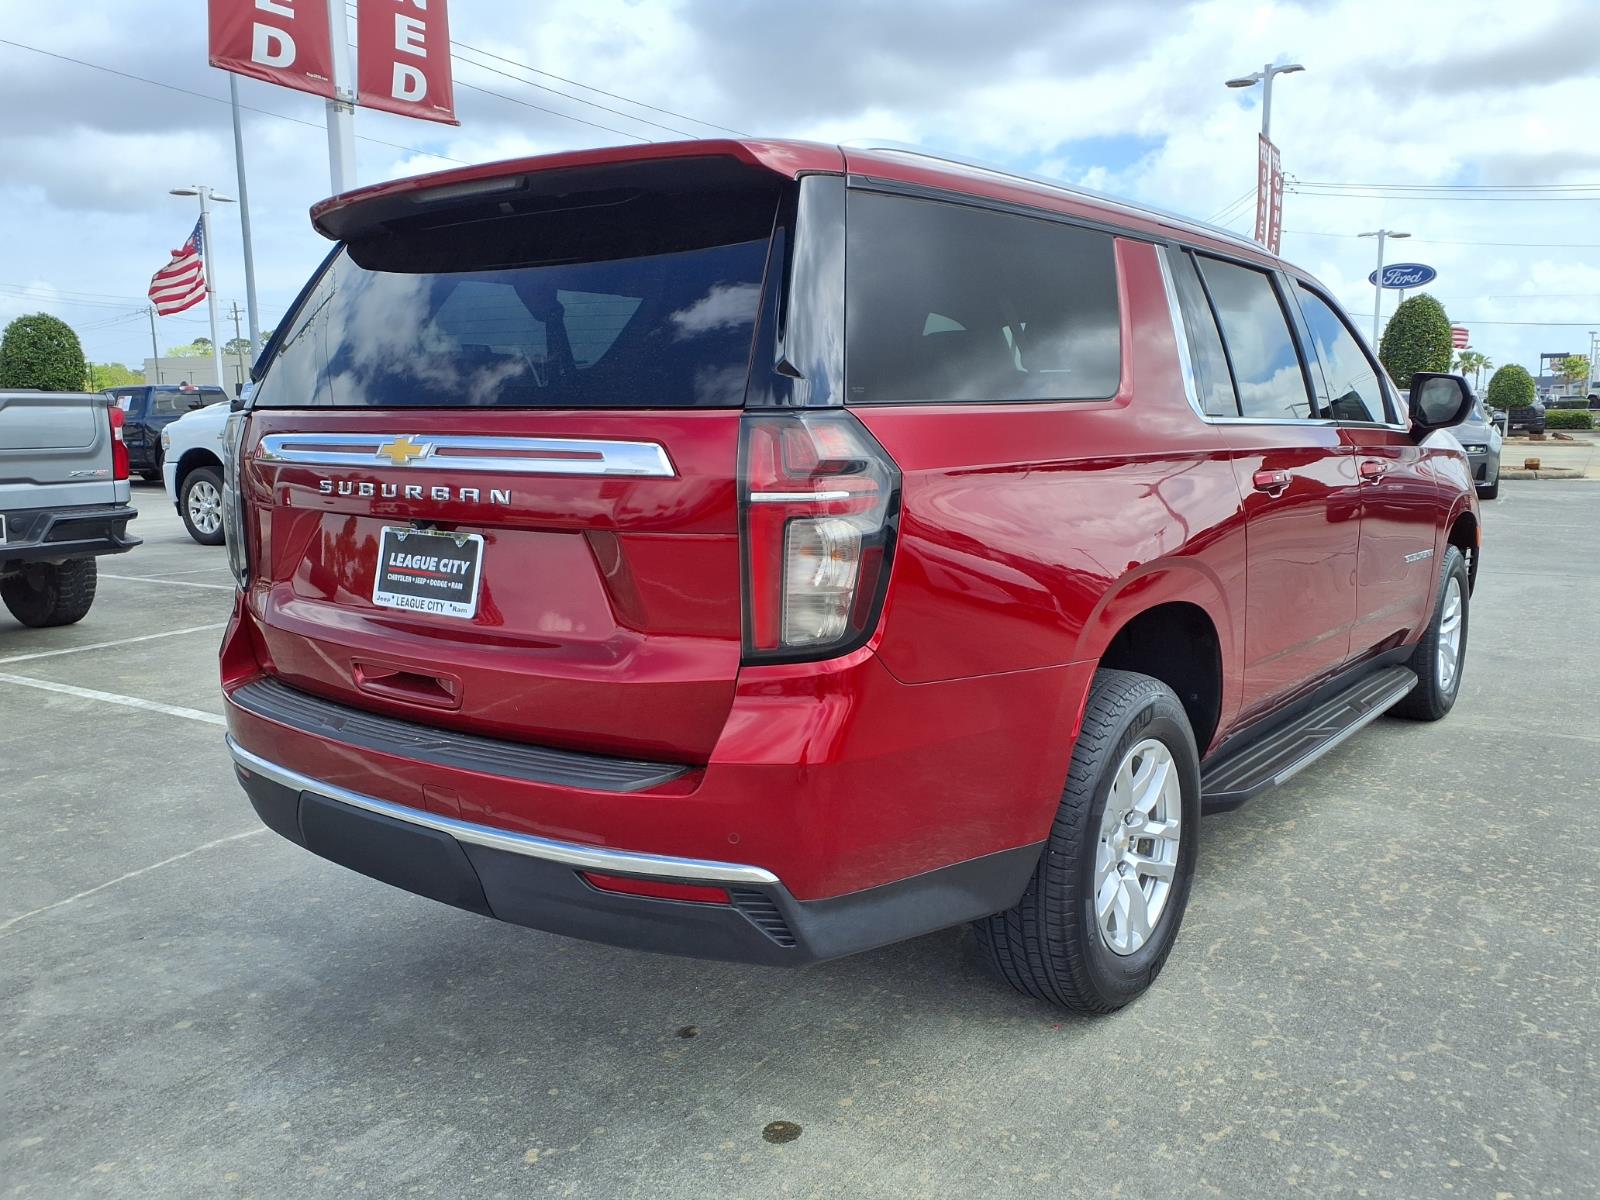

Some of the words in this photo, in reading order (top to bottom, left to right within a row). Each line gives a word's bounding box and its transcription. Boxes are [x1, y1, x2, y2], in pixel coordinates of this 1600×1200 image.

[391, 0, 428, 102] ED
[1382, 268, 1423, 285] Ford
[319, 480, 512, 505] SUBURBAN
[389, 552, 438, 571] LEAGUE
[440, 559, 470, 575] CITY
[387, 573, 412, 583] CHRYSLER
[415, 576, 427, 585] JEEP
[429, 579, 448, 588] DODGE
[450, 582, 463, 590] RAM
[396, 596, 425, 610] LEAGUE
[427, 601, 446, 612] CITY
